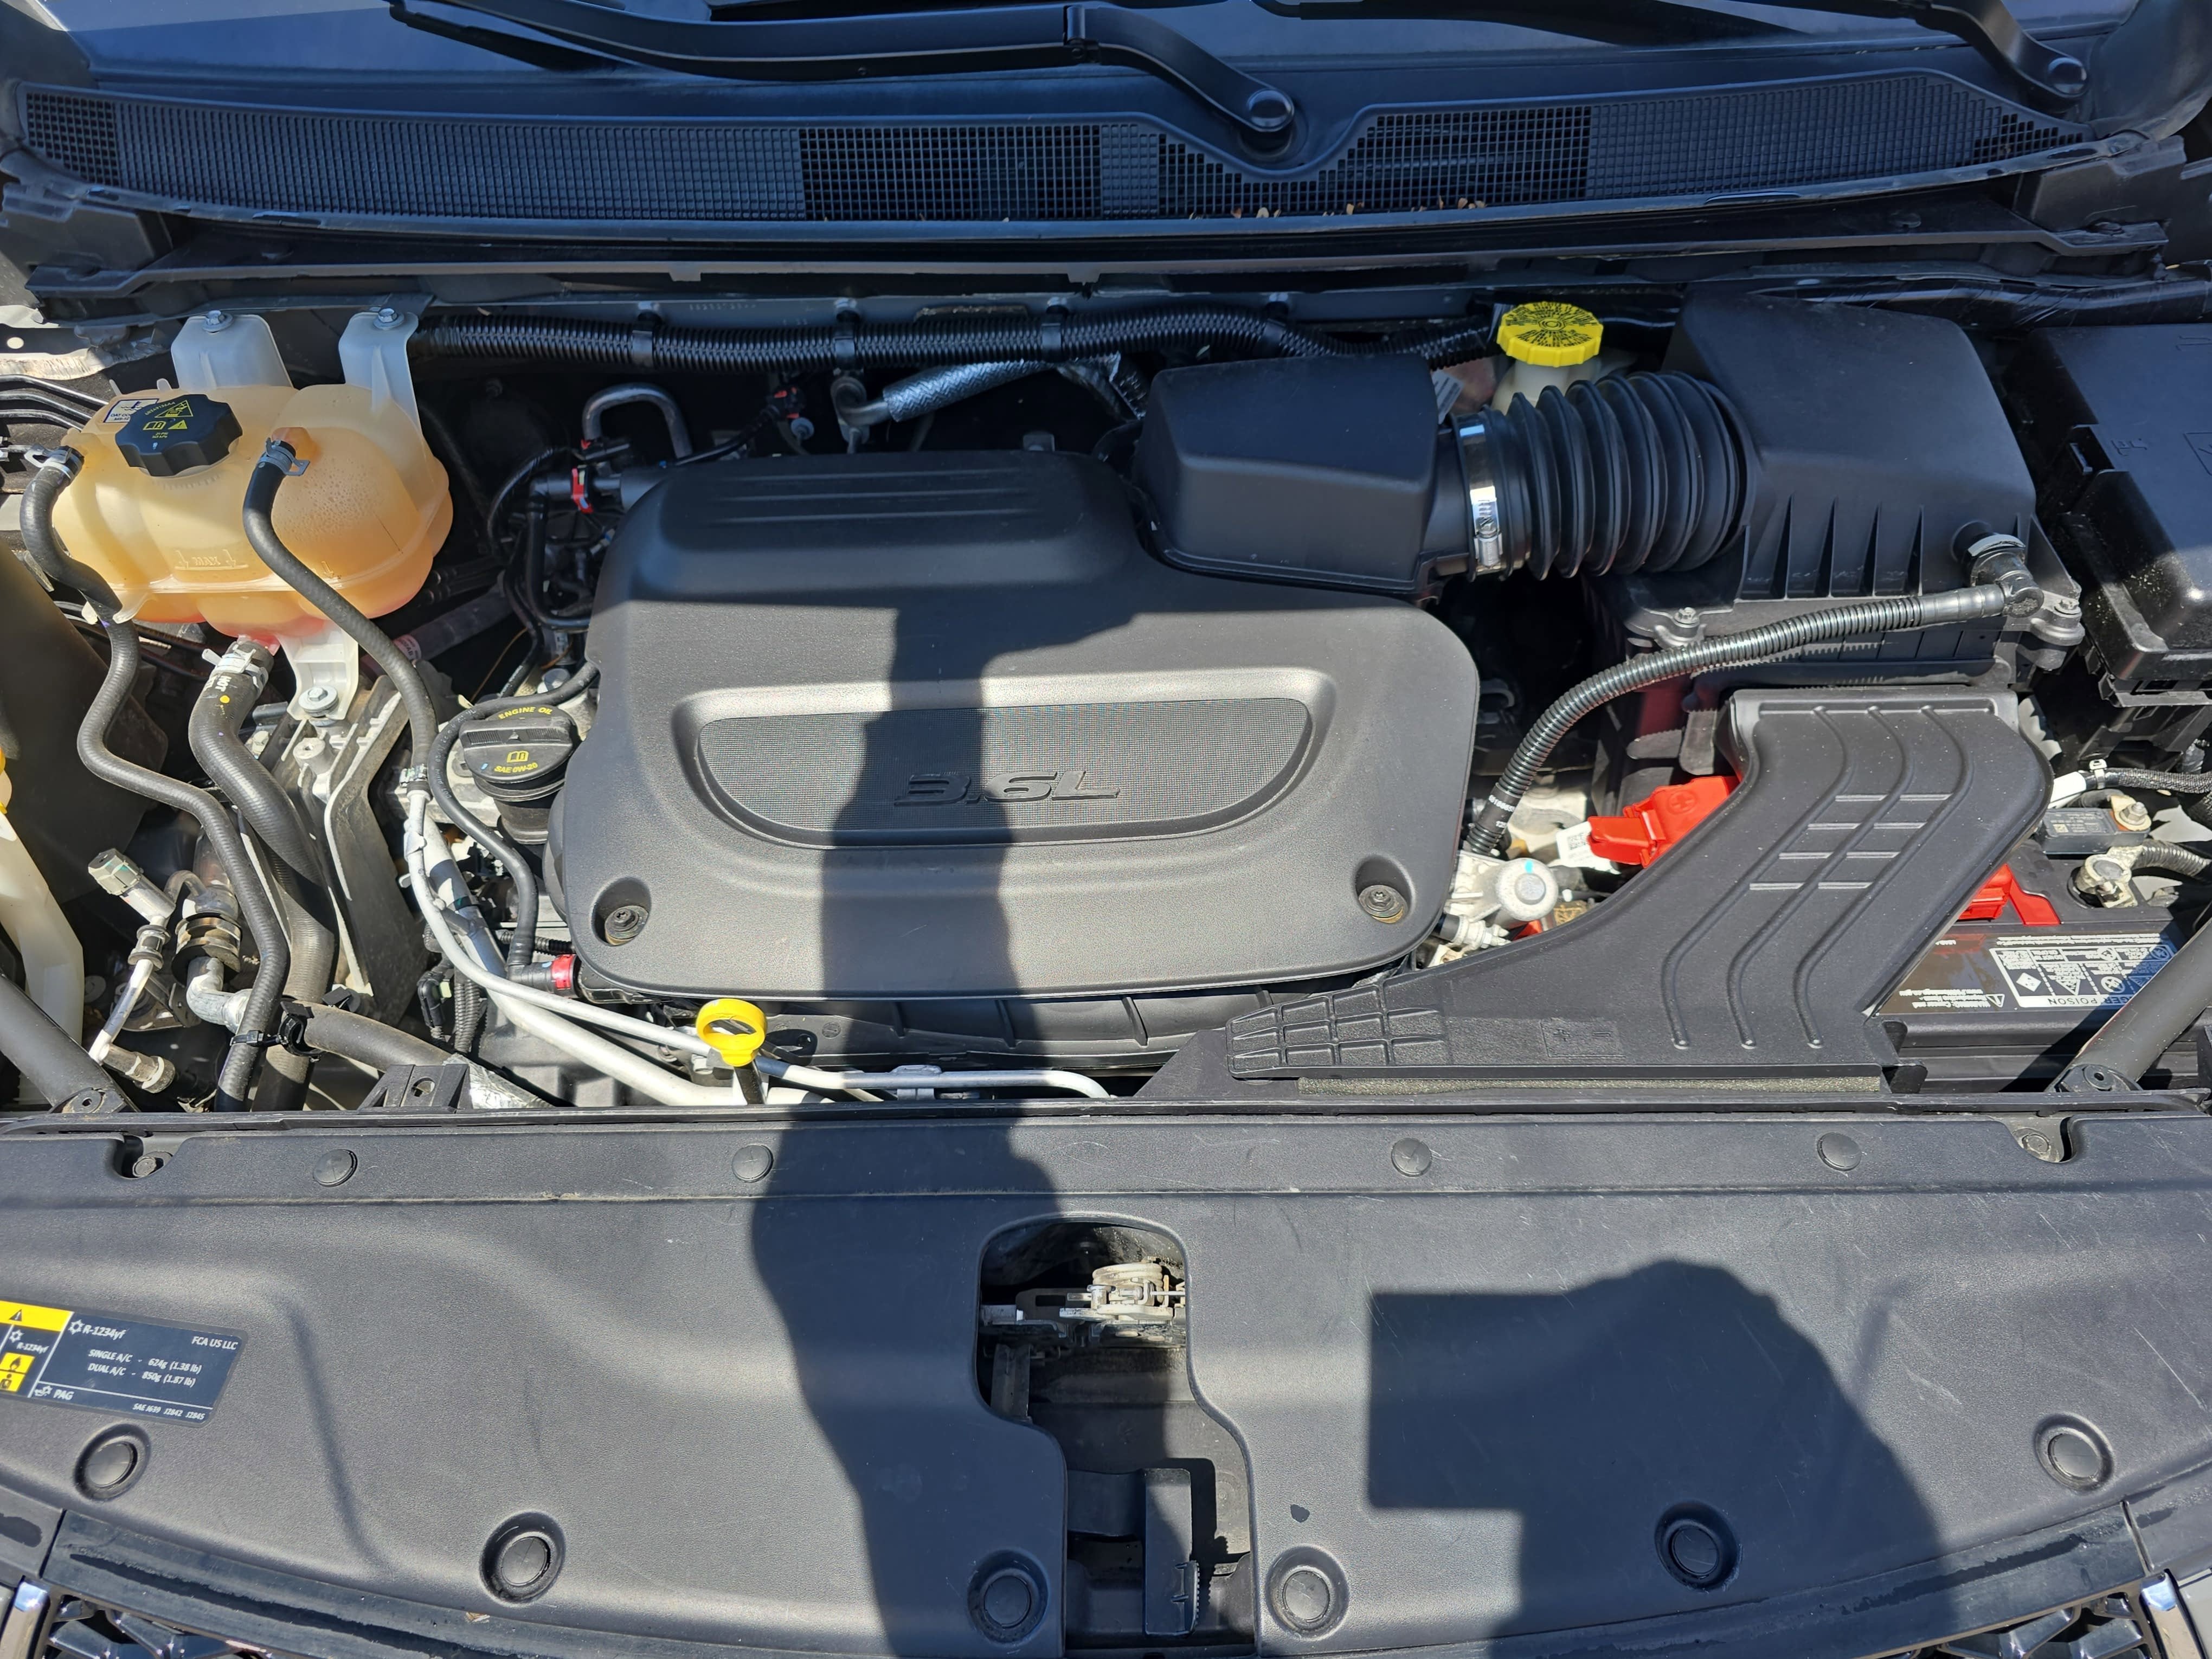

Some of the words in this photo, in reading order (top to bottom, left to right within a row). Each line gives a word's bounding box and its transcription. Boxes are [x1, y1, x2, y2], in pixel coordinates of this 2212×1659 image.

[498, 706, 536, 719] ENGINE
[538, 707, 553, 715] OIL
[512, 762, 538, 773] 0W-20
[894, 770, 1121, 807] 3.6L
[82, 1324, 126, 1340] R-1234yf
[16, 1342, 49, 1354] R-1234yf
[191, 1336, 209, 1346] FCA
[209, 1339, 222, 1348] US
[222, 1341, 239, 1351] LLC
[88, 1349, 117, 1360] SINGLE
[115, 1353, 133, 1363] A/C
[148, 1358, 168, 1369] 624g
[169, 1361, 191, 1372] (1.38
[190, 1364, 202, 1374] lb)
[88, 1363, 110, 1373] DUAL
[109, 1366, 126, 1376] A/C
[142, 1371, 162, 1382] 850g
[163, 1374, 185, 1384] (1.87
[184, 1377, 196, 1387] lb)
[53, 1389, 75, 1400] PAG
[132, 1403, 146, 1411] SAE
[145, 1405, 162, 1413] J639
[163, 1408, 183, 1417] J2842
[185, 1411, 205, 1420] J2845
